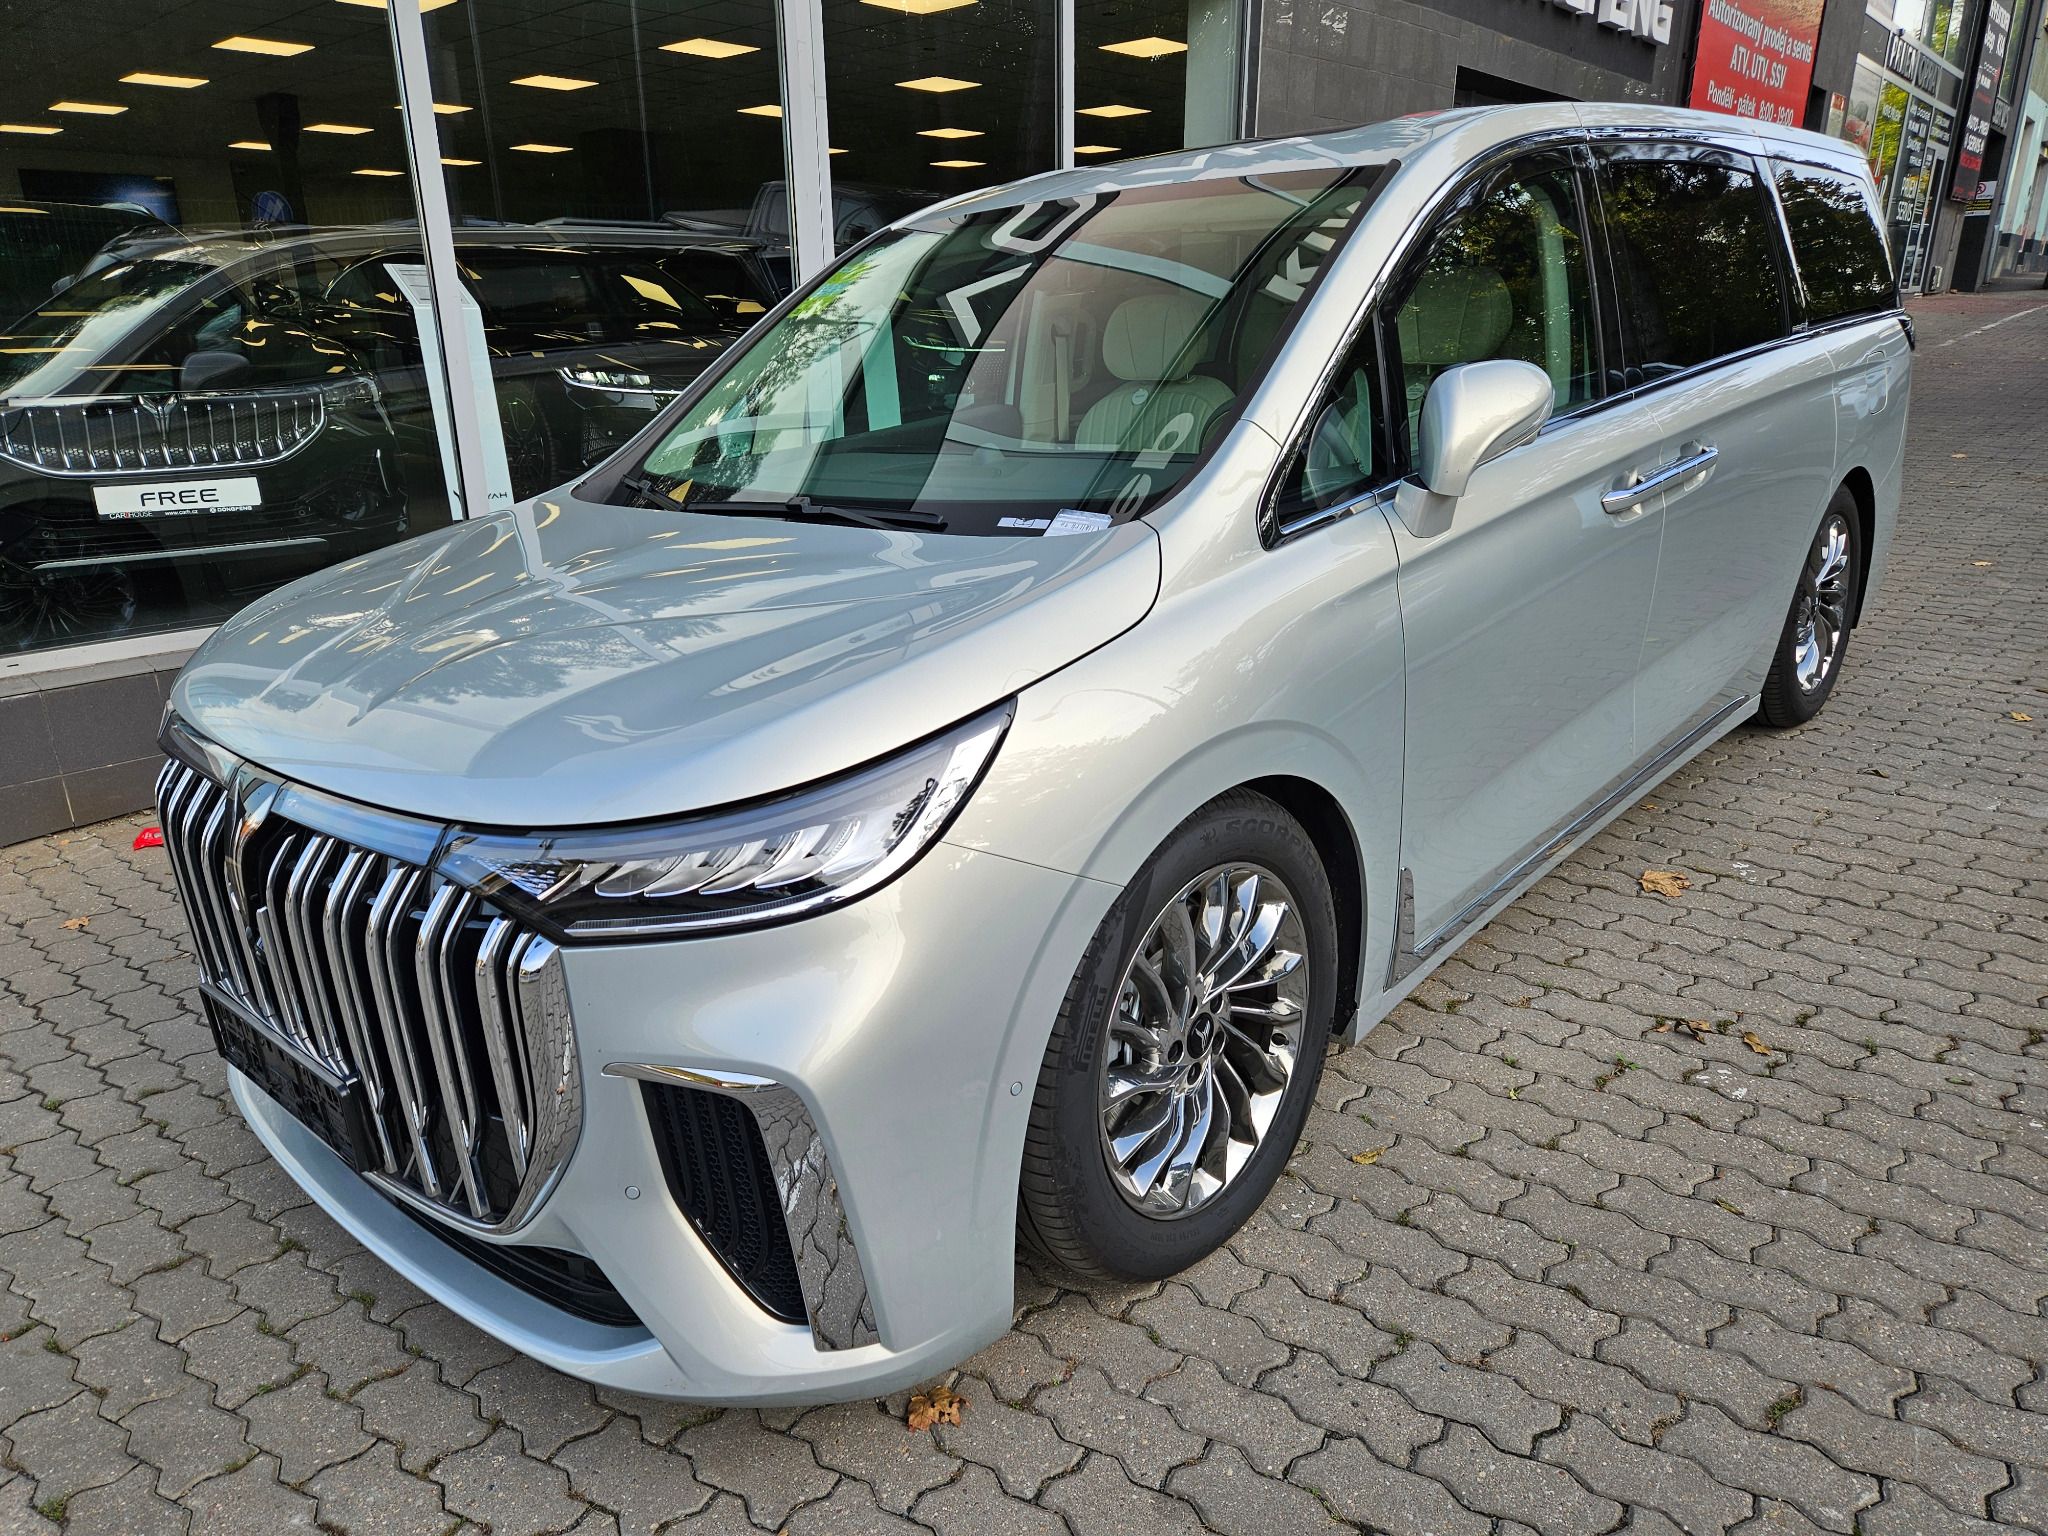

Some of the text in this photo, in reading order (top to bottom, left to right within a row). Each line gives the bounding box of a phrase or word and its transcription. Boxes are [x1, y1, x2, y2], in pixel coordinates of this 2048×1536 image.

[1708, 0, 1812, 64] Autorizovaný prodej a servis
[1730, 44, 1787, 89] ATV, UTV, SSV
[1707, 79, 1735, 109] Pondělí
[1736, 93, 1756, 116] pátek
[1758, 100, 1774, 122] 8:00
[140, 488, 219, 507] FREE
[217, 505, 253, 513] DONGFENG
[1071, 984, 1108, 1072] PIRELLI
